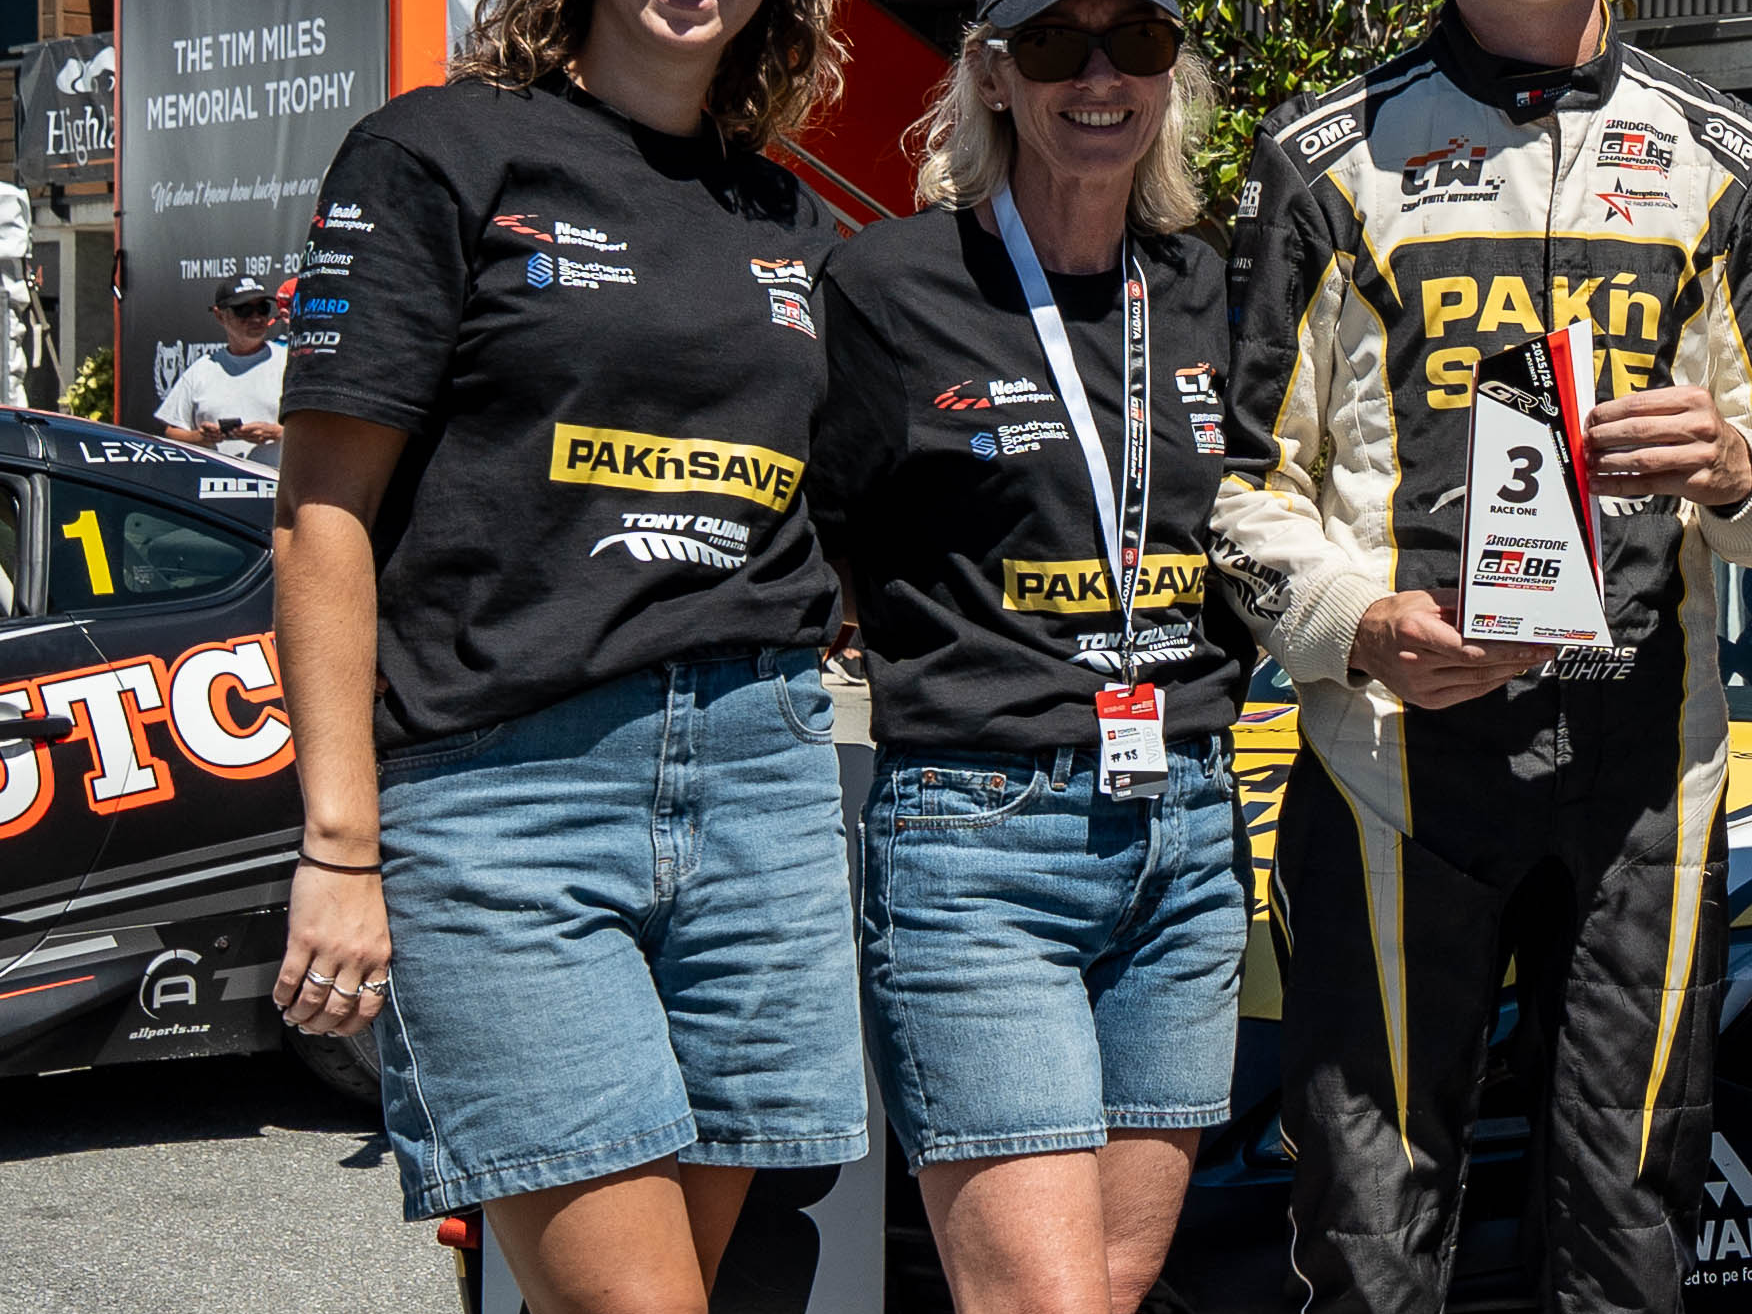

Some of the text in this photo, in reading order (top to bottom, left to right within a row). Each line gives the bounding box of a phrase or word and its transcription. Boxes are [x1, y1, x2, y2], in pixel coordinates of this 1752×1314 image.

[174, 17, 327, 75] THE TIM MILES
[148, 71, 356, 131] MEMORIAL TROPHY
[46, 105, 115, 166] Highla
[1300, 118, 1357, 155] OMP
[1598, 155, 1663, 165] CHAMPIONS
[152, 181, 171, 214] We
[173, 178, 202, 207] don't
[231, 176, 252, 202] how
[253, 175, 281, 209] lucky
[283, 180, 297, 195] we
[298, 178, 318, 196] are
[554, 221, 608, 243] Neale
[557, 235, 628, 252] Motorsport
[181, 260, 200, 279] TIM
[203, 257, 237, 278] MILES
[245, 255, 272, 277] 1967
[284, 254, 301, 276] 20
[557, 257, 634, 276] Southern
[558, 265, 638, 285] Specialist
[559, 275, 599, 289] Cars
[1130, 300, 1141, 340] TOYOTA
[1531, 341, 1554, 388] 2025/26
[989, 377, 1038, 396] Neale
[1426, 346, 1656, 411] SVE
[994, 392, 1056, 406] Motorsport
[998, 420, 1066, 437] Southern
[1001, 427, 1070, 447] Specialist
[1003, 442, 1041, 456] Cars
[567, 437, 795, 500] PAK'nSAVE
[1497, 446, 1543, 503] 3
[1490, 505, 1537, 516] RACE ONE
[622, 513, 750, 540] TONY QUINN
[62, 510, 114, 594] 1
[1485, 534, 1568, 551] BRIDGESTONE
[1478, 557, 1562, 578] GR 86
[1474, 574, 1557, 585] CHAMPIONSHIP
[1558, 646, 1637, 662] CHRIS
[1703, 1271, 1718, 1285] to
